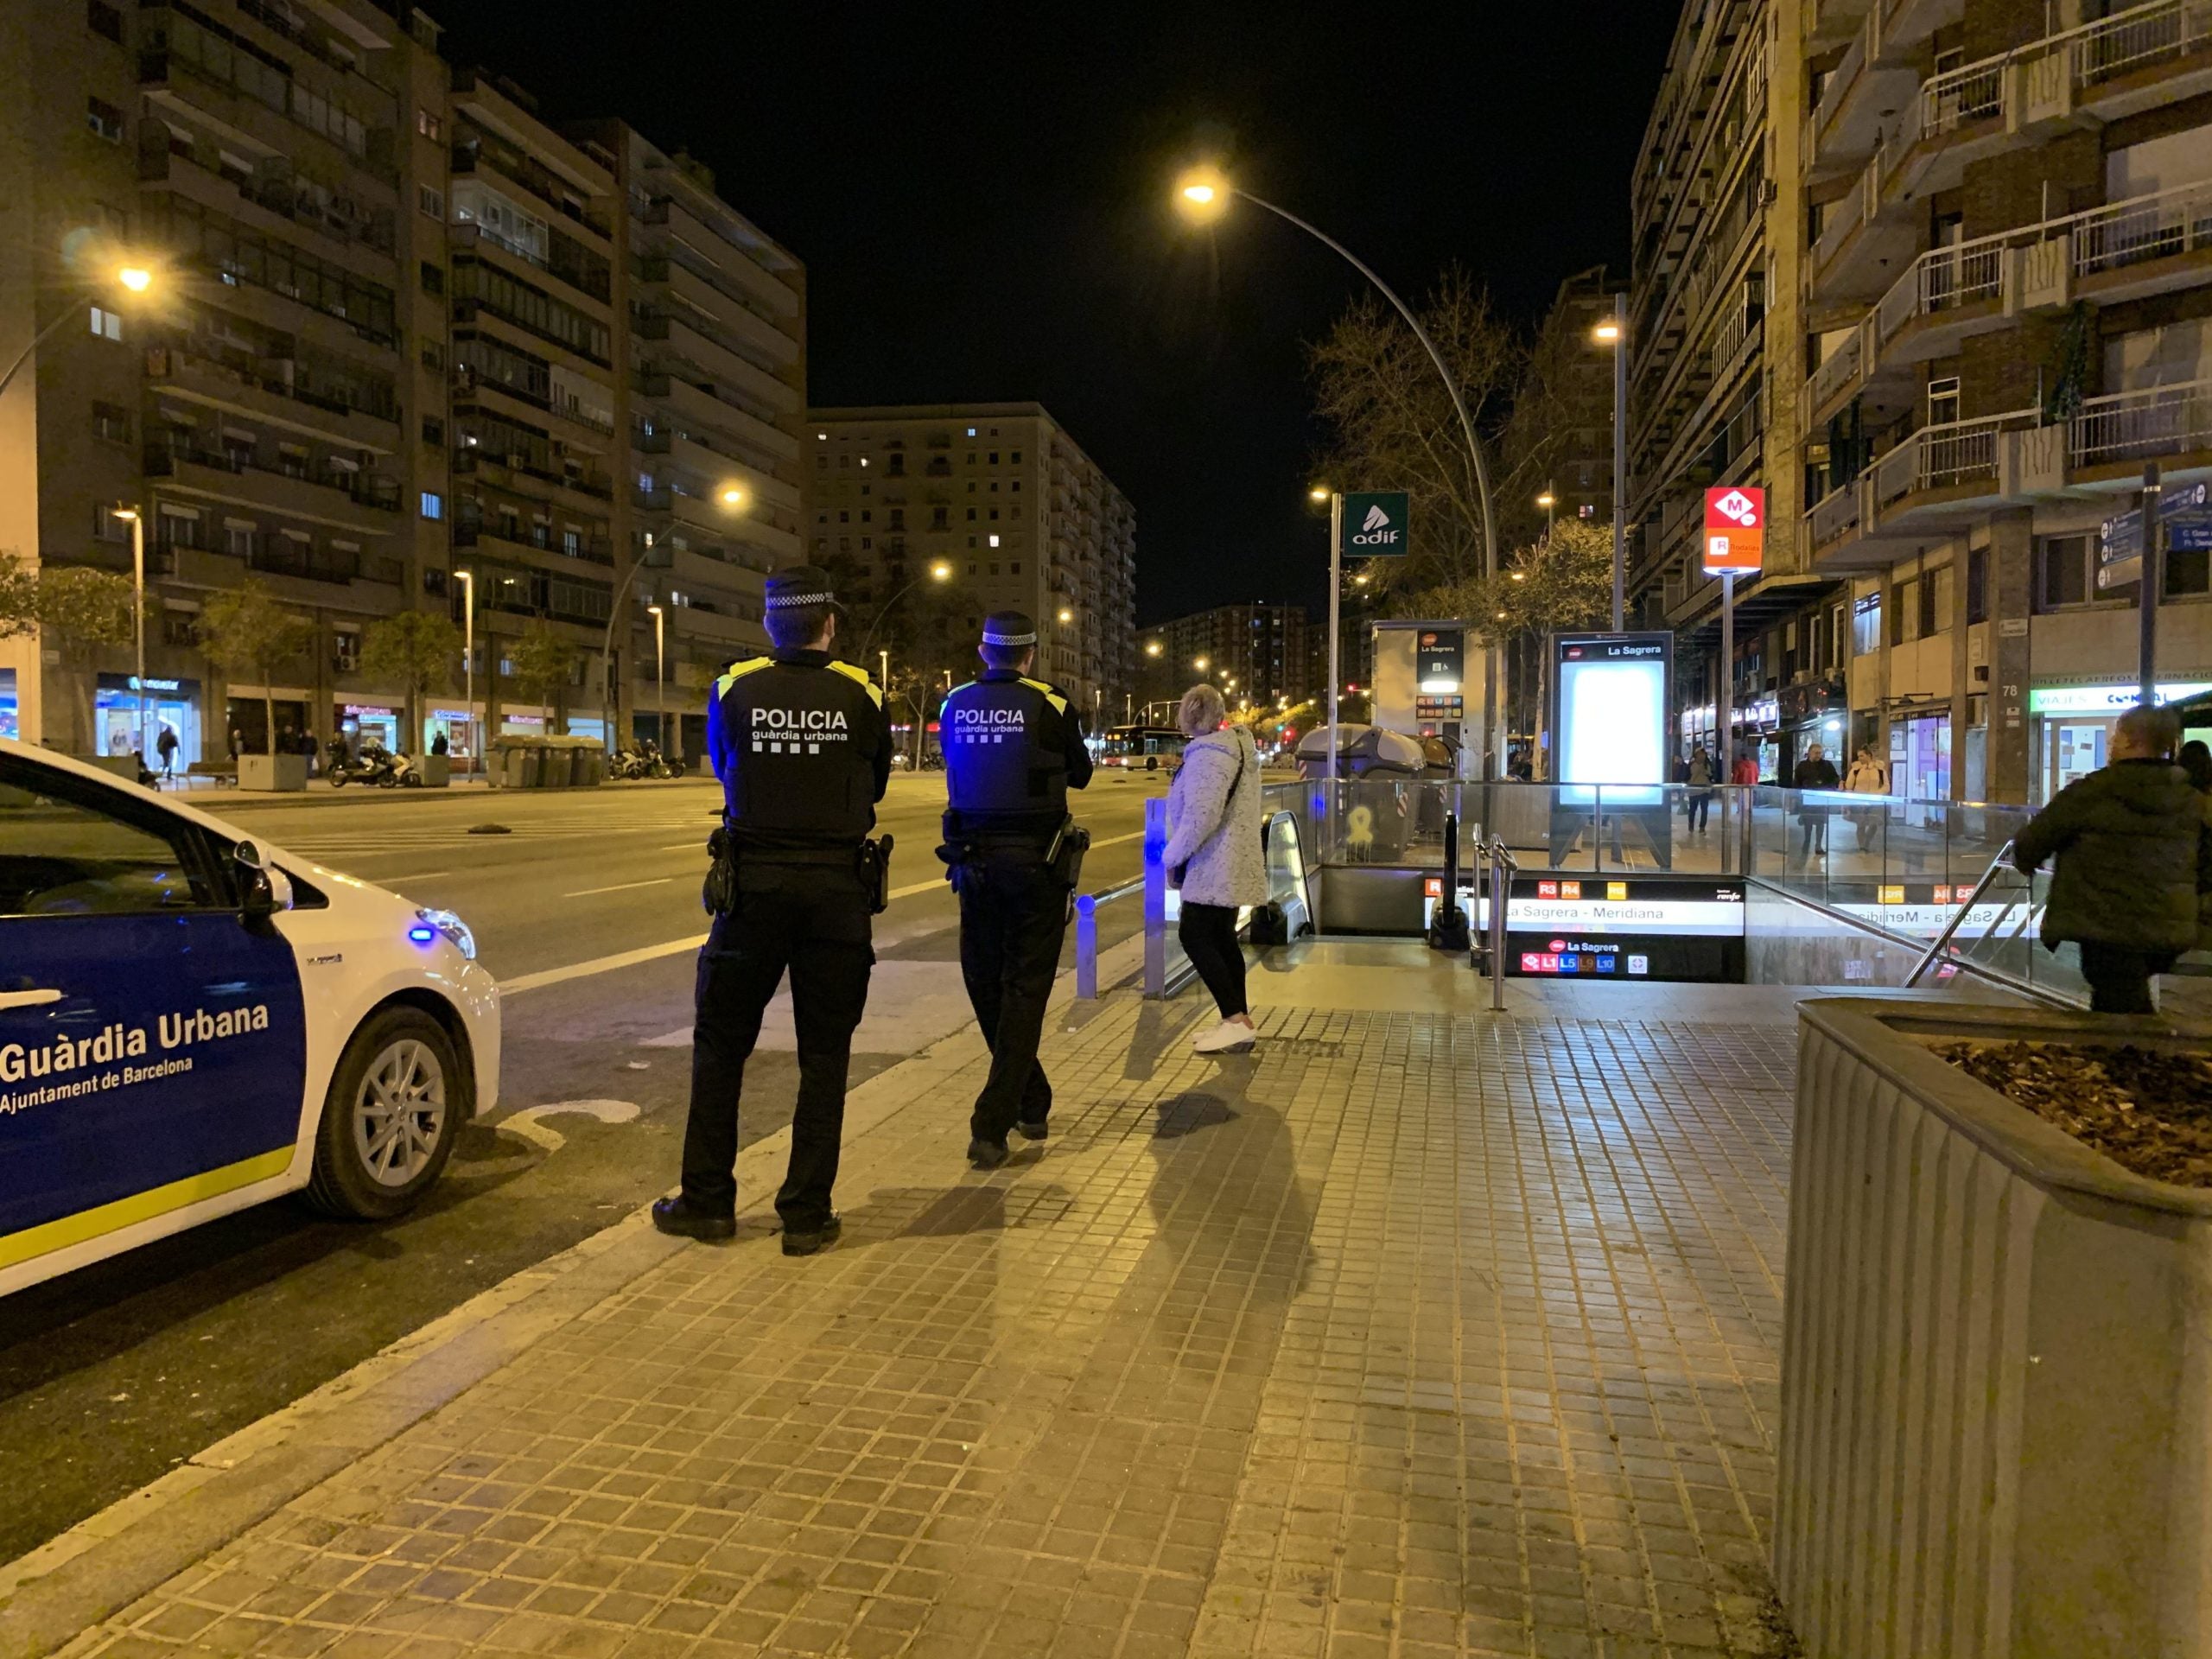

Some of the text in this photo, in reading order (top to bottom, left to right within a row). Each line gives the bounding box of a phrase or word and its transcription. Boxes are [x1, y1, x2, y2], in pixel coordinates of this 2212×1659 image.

[1727, 499, 1742, 512] M
[1352, 530, 1400, 544] adif
[1717, 541, 1726, 550] R
[1608, 645, 1662, 657] La Sagrera
[2003, 685, 2018, 696] 78
[752, 709, 848, 729] POLICIA
[954, 709, 1025, 724] POLICIA
[752, 730, 848, 741] guàrdia urbana
[954, 725, 988, 734] guàrdia
[1539, 884, 1556, 895] R3
[1561, 885, 1580, 896] R4
[1716, 892, 1740, 902] renfe
[1507, 908, 1518, 917] a
[1523, 906, 1579, 919] Sagrera
[1593, 907, 1664, 919] Meridiana
[1567, 942, 1580, 950] La
[1581, 943, 1619, 953] Sagrera
[1542, 957, 1555, 968] L1
[1560, 958, 1575, 968] L5
[1580, 958, 1594, 969] L9
[1597, 959, 1613, 969] L10
[0, 1004, 269, 1083] Guàrdia Urbana
[0, 1057, 193, 1116] Ajuntament de Barcelona
